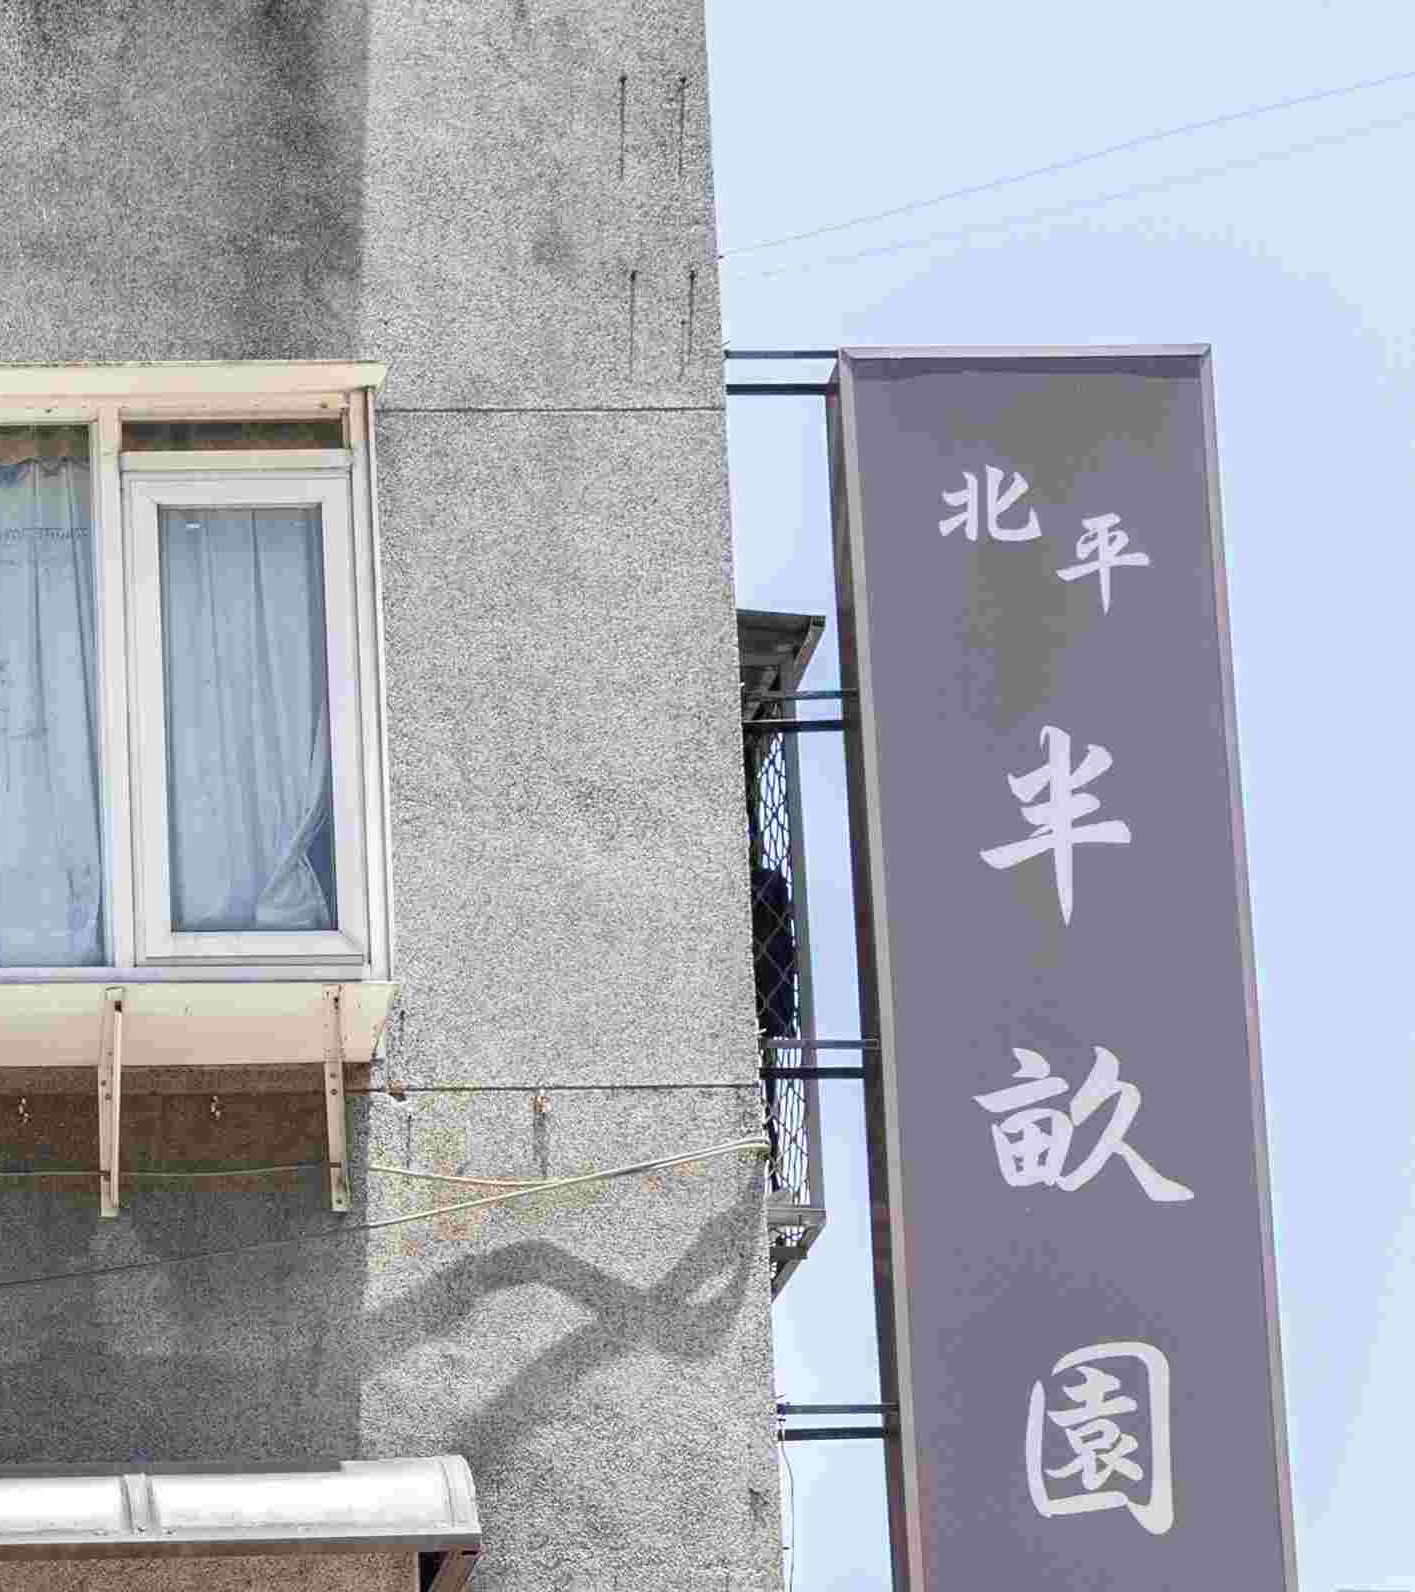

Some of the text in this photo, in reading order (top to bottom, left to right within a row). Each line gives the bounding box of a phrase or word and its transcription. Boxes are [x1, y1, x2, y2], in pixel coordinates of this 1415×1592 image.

[937, 464, 1151, 615] 北平
[973, 724, 1196, 1535] 半畝園
